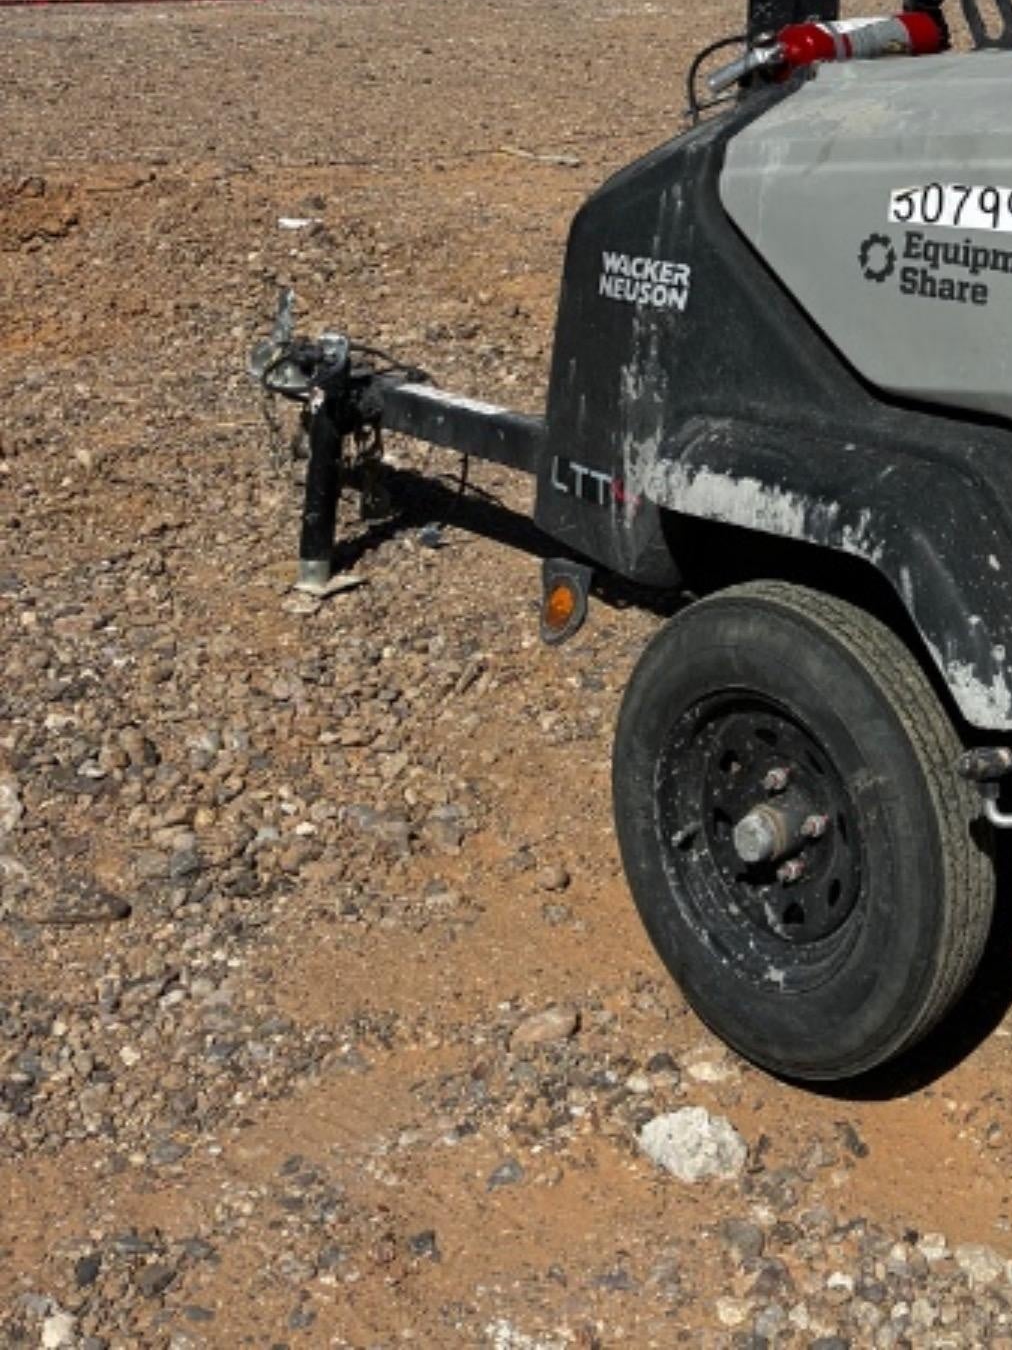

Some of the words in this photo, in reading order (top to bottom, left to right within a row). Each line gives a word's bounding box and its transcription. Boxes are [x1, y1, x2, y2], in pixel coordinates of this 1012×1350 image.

[602, 250, 691, 286] WACKER
[900, 267, 988, 305] Share
[598, 272, 688, 312] NEUSON
